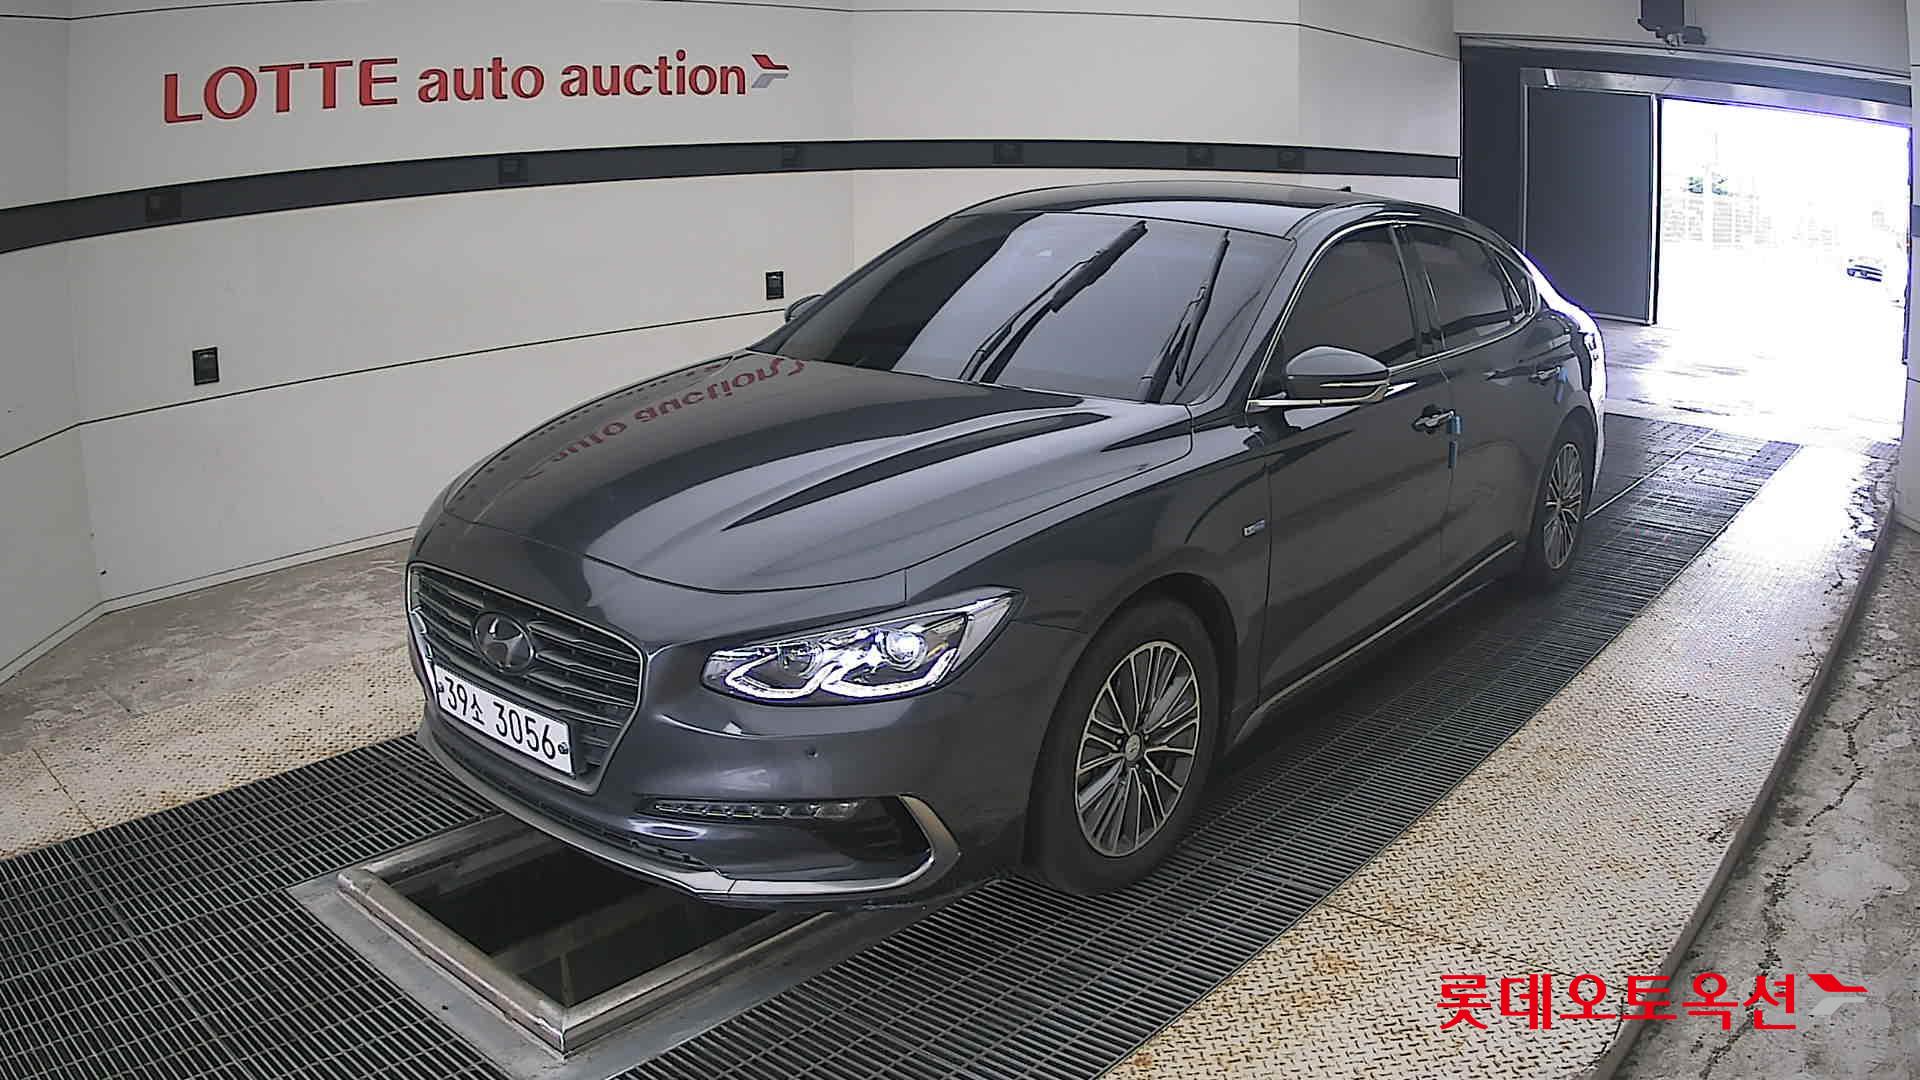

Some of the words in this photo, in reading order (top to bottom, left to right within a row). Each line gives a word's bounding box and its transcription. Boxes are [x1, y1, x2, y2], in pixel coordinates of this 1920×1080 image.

[164, 57, 398, 123] LOTTE
[417, 56, 545, 103] auto
[560, 48, 746, 97] auction
[443, 676, 486, 726] 39소
[492, 701, 556, 761] 3056
